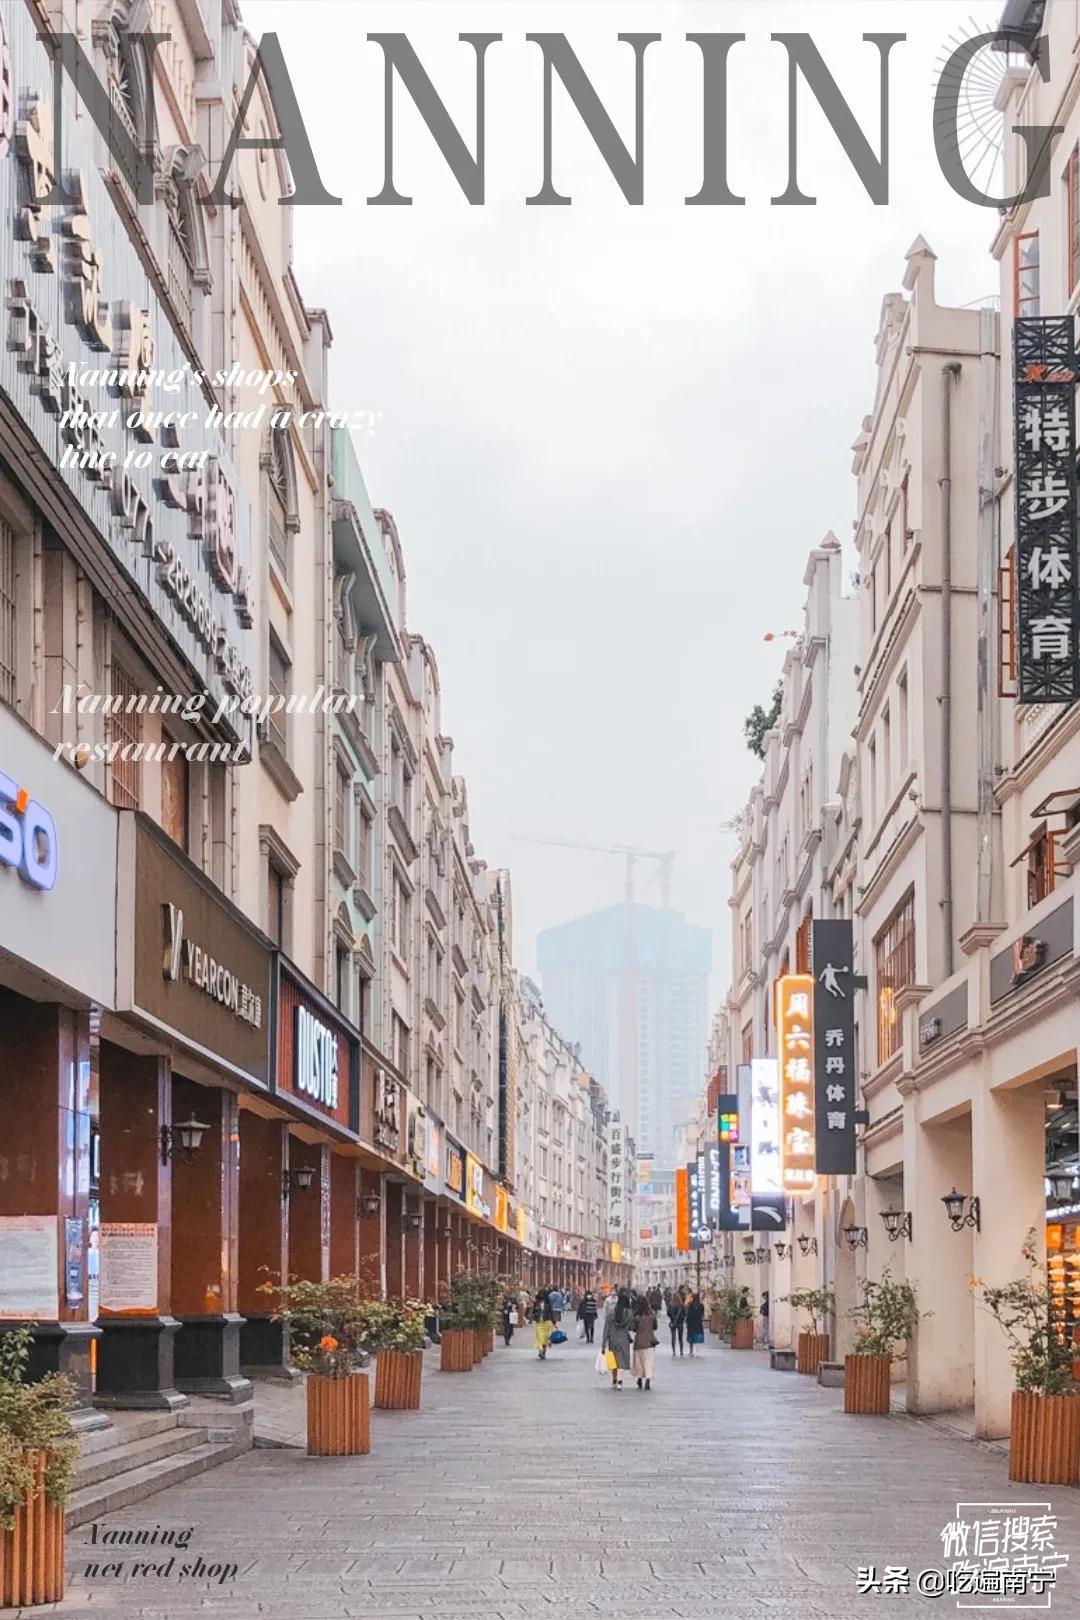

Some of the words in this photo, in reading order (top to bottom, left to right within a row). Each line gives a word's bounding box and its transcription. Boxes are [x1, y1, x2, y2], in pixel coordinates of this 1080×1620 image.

[1025, 407, 1072, 661] 特步体育
[186, 939, 238, 1012] YEARCON
[825, 1028, 847, 1130] 乔丹体育
